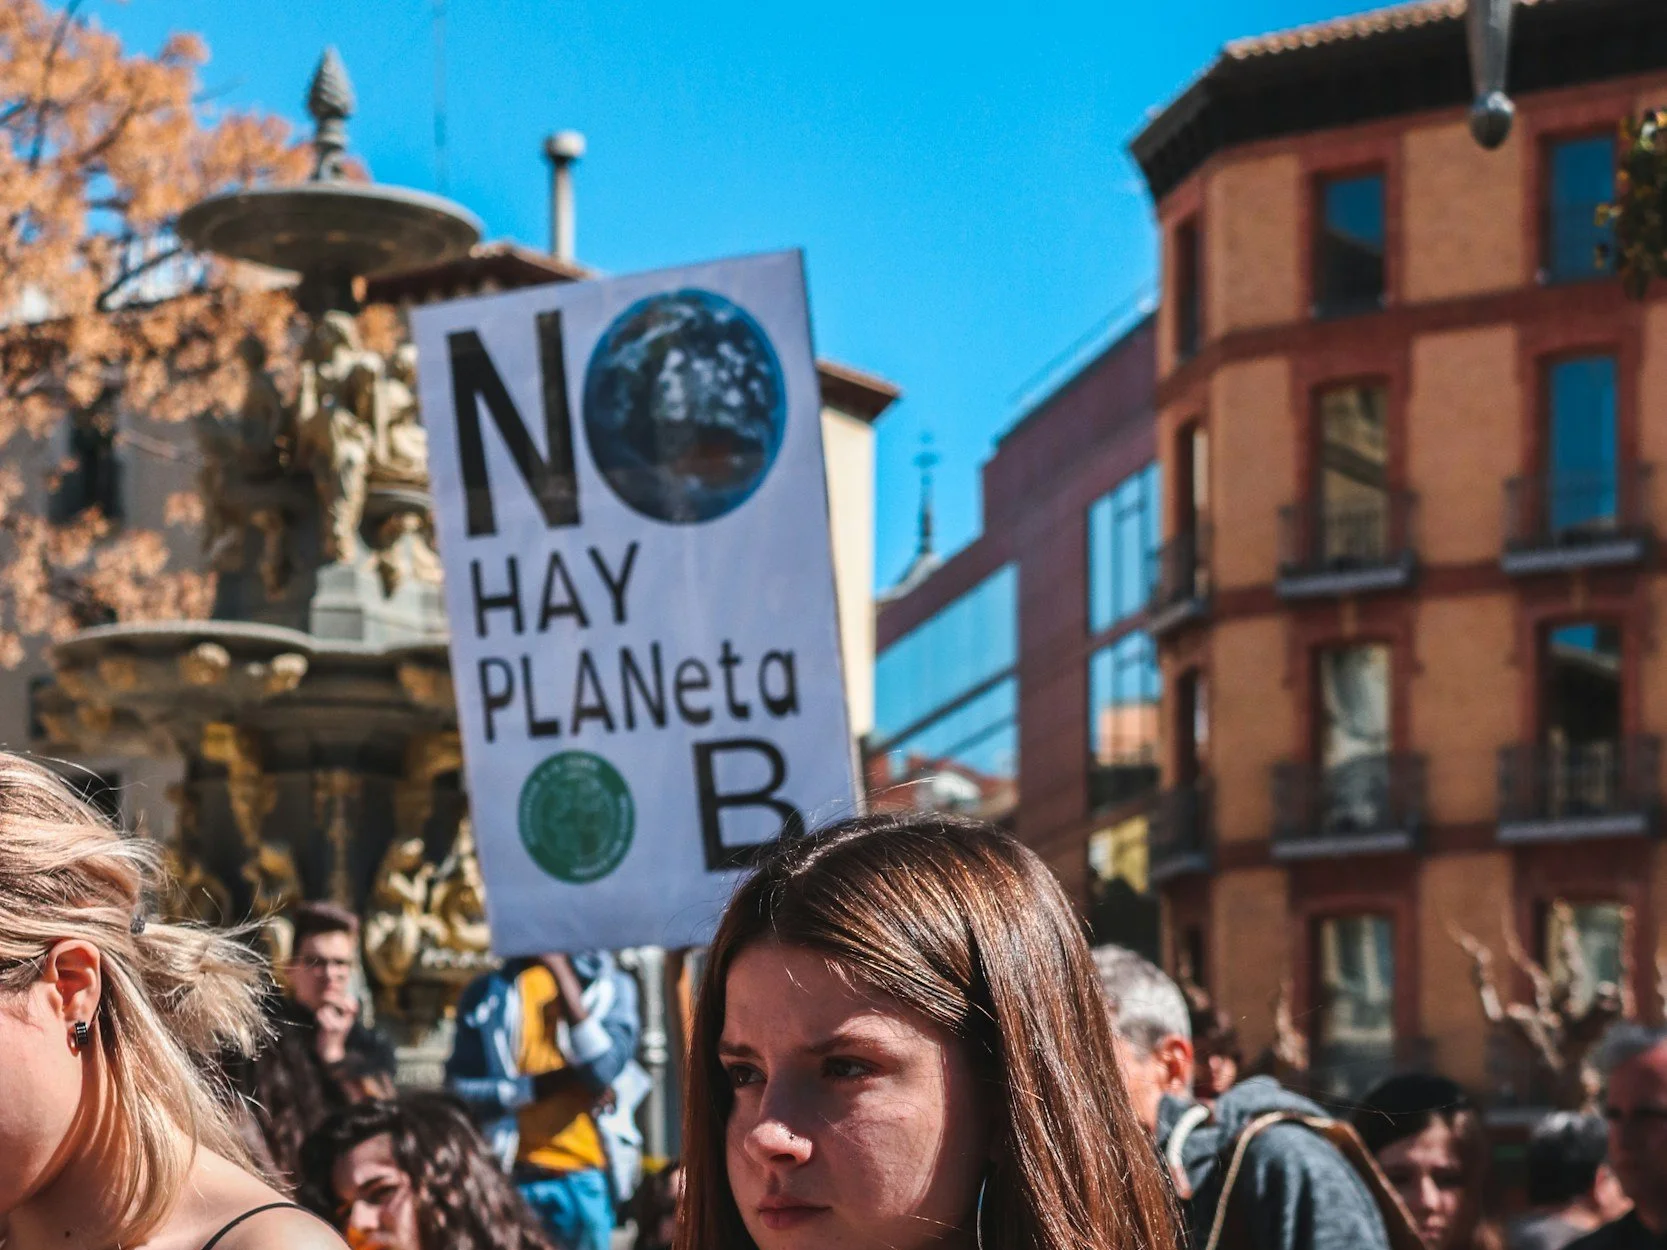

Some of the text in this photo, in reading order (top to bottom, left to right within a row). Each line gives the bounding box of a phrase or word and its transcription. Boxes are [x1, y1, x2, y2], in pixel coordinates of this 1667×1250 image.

[471, 541, 641, 637] HAY
[477, 640, 801, 743] PLANeta
[692, 737, 806, 873] B
